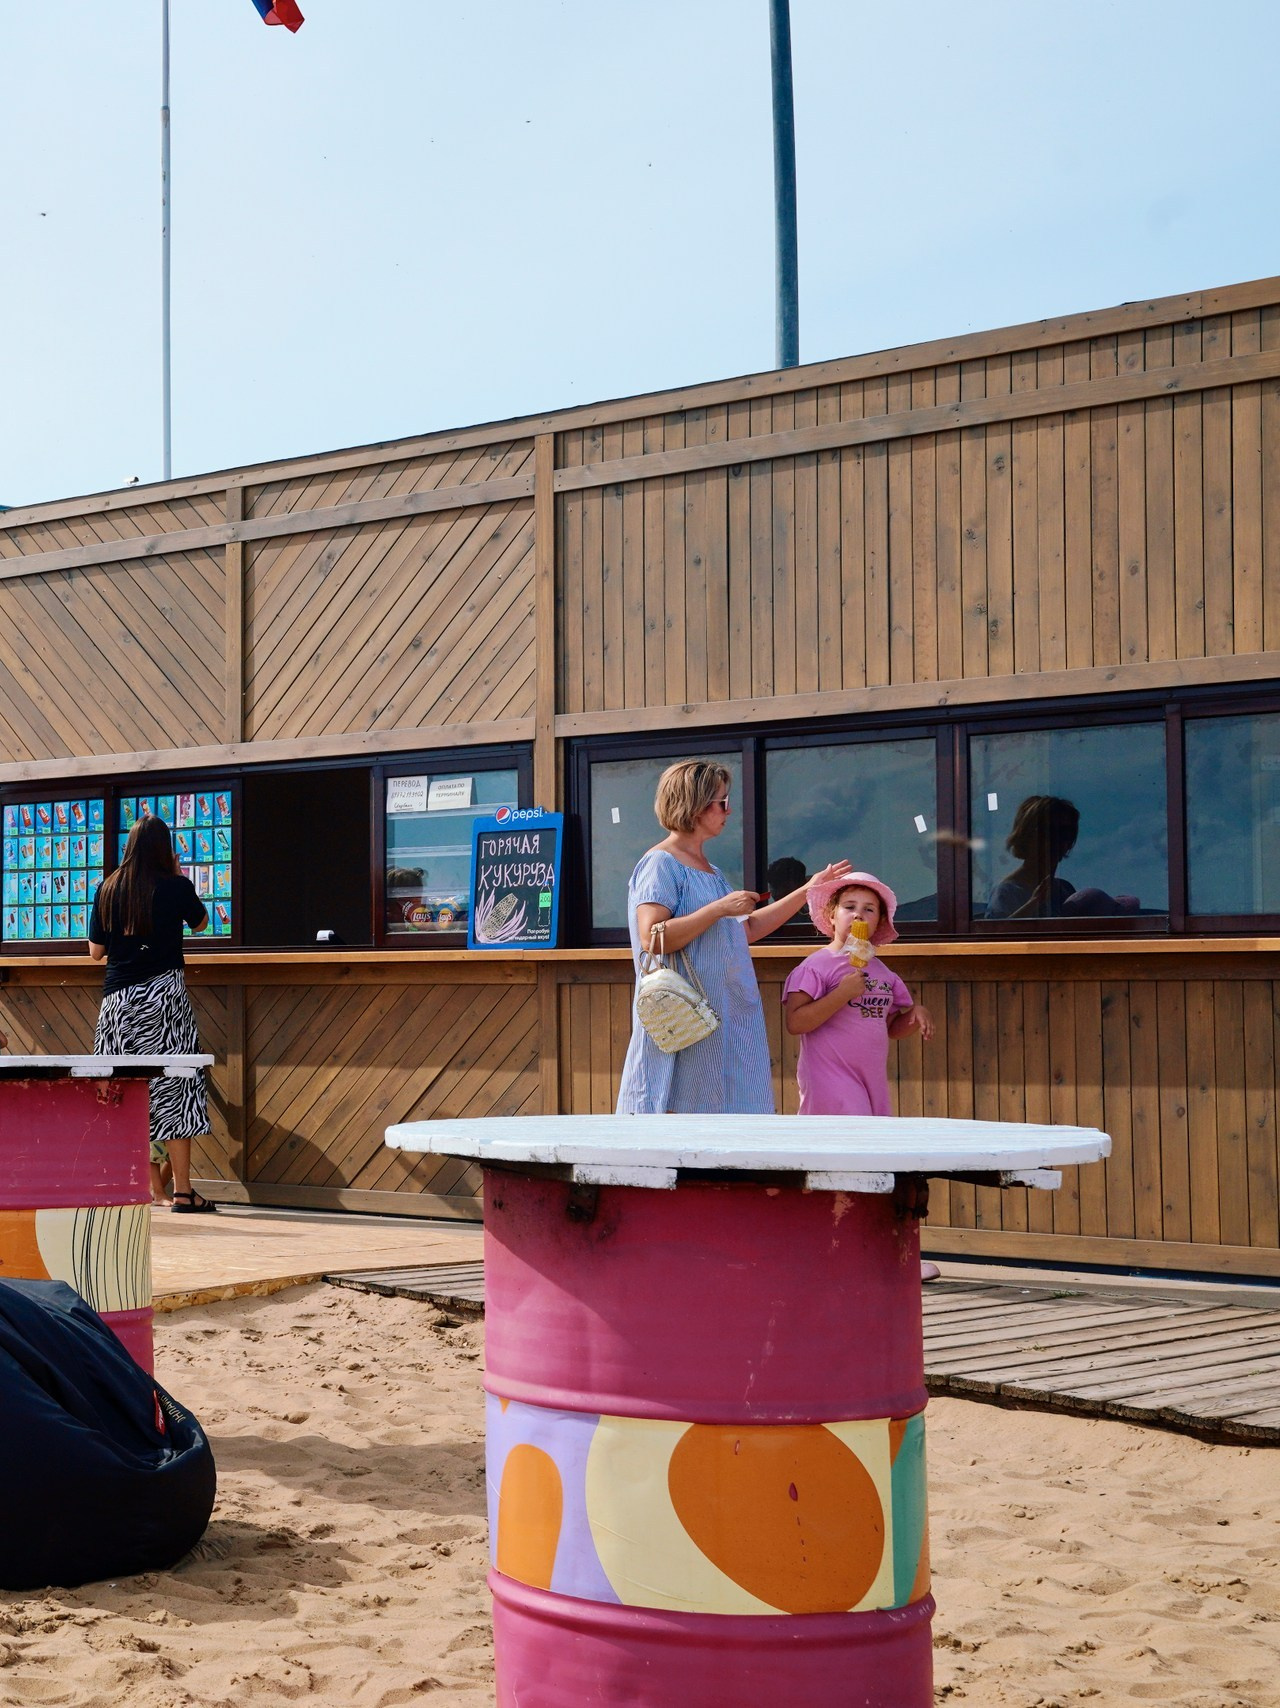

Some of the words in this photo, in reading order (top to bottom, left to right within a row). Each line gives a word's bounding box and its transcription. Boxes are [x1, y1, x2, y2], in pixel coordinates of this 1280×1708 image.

[392, 780, 422, 788] ПЕРЕВОД
[512, 806, 543, 822] pepsi
[481, 834, 540, 859] ГОРЯЧАЯ
[478, 862, 555, 891] КУКУРУЗА
[412, 912, 431, 922] Lay's
[848, 995, 890, 1010] Queen
[861, 1006, 884, 1018] BEE
